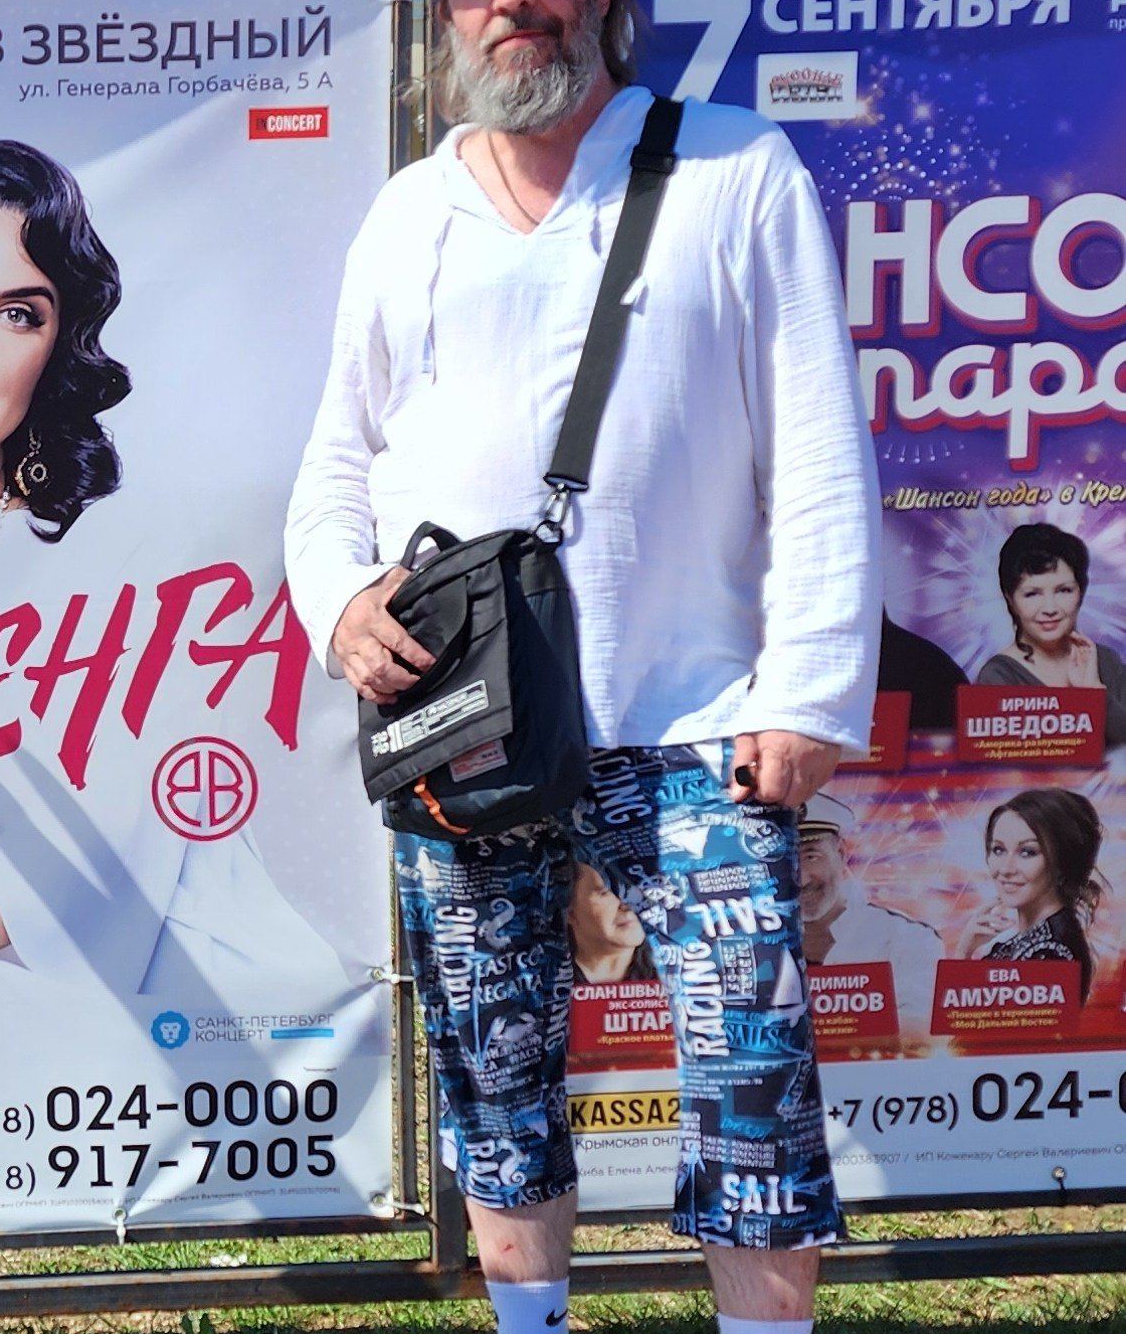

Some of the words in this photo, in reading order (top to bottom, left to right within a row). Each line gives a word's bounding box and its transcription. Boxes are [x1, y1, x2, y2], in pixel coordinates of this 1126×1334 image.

[21, 5, 332, 70] ЗВЁЗДНЫЙ
[19, 82, 50, 101] ул.
[57, 78, 161, 100] Генерала
[168, 74, 291, 98] Горбачёва,
[297, 72, 309, 90] 5
[317, 71, 333, 90] А
[883, 487, 980, 511] «Шансон
[986, 482, 1051, 507] года»
[1059, 488, 1072, 503] в
[1001, 696, 1060, 712] ИРИНА
[966, 713, 1094, 739] ШВЕДОВА
[988, 968, 1021, 983] ЕВА
[572, 984, 617, 1001] СЛАН
[682, 941, 730, 1056] RACING
[942, 984, 1066, 1008] АМУРОВА
[195, 1013, 335, 1029] САНКТ-ПЕТЕРБУРГ
[195, 1029, 264, 1043] КОНЦЕРТ
[46, 1078, 338, 1133] 024-0000
[570, 1097, 681, 1127] KASSA2
[828, 1098, 864, 1128] +7
[871, 1092, 960, 1134] (978)
[971, 1070, 1126, 1123] 024-
[575, 1136, 649, 1152] Крымская
[47, 1134, 336, 1189] 917-7005
[721, 1172, 807, 1215] SAIL
